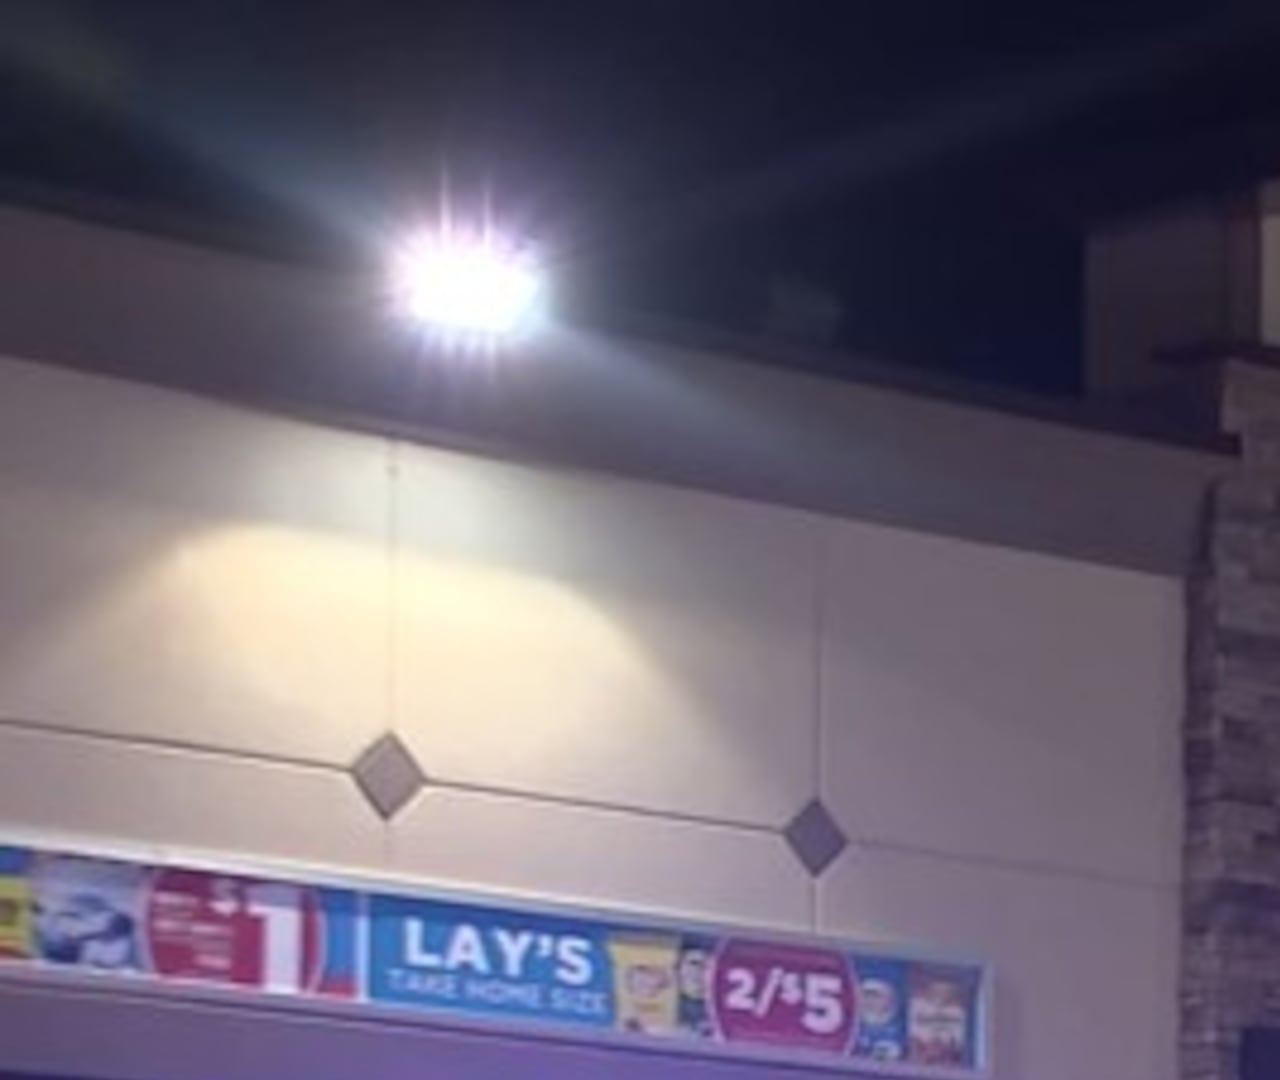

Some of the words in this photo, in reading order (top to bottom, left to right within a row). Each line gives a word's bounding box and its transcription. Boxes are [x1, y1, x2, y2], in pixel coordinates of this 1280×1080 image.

[404, 918, 594, 985] LAY'S
[386, 967, 457, 999] TAKE
[464, 978, 541, 1008] HOME
[724, 965, 844, 1034] 2/$5
